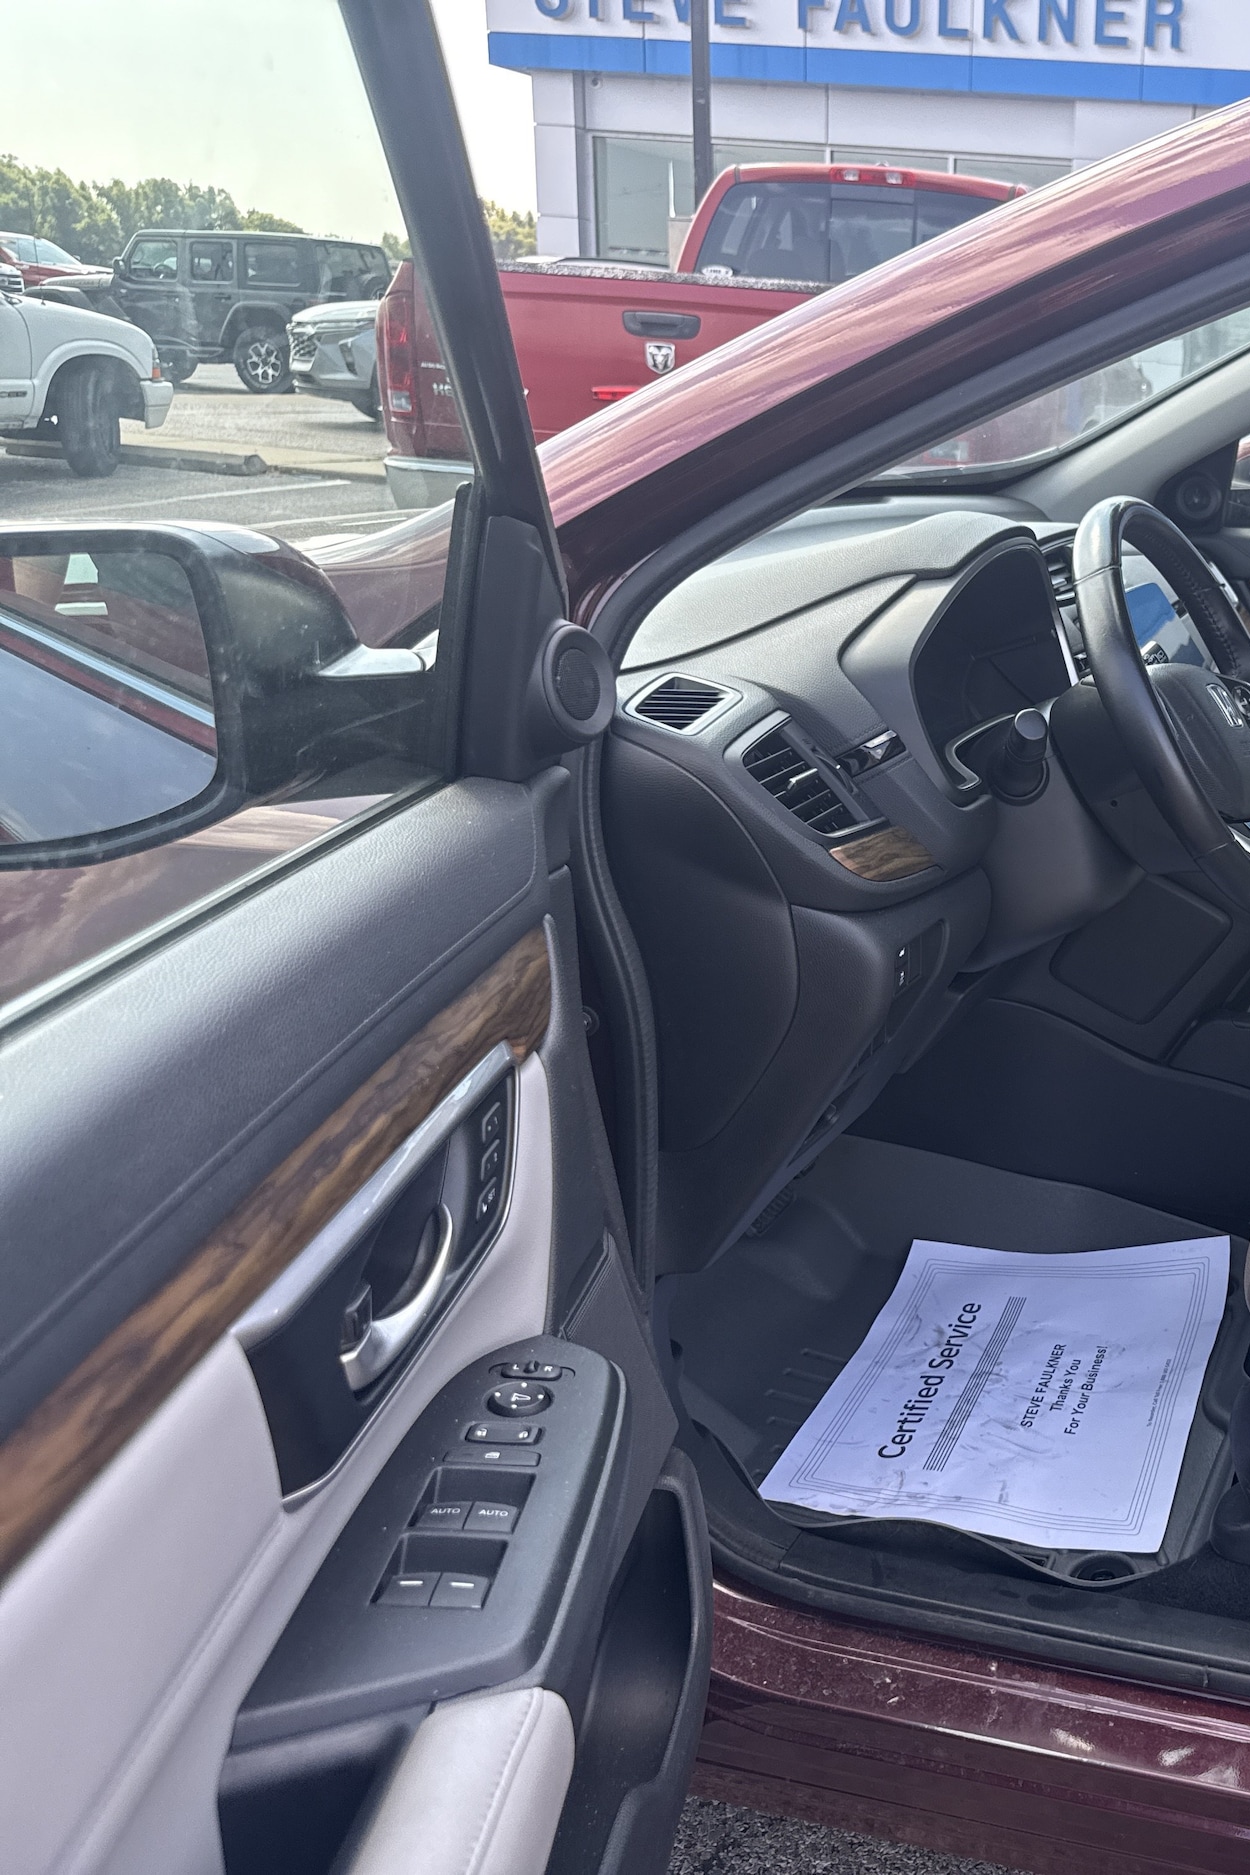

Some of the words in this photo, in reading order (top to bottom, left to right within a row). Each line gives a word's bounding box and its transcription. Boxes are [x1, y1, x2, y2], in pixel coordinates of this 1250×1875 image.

[877, 1375, 946, 1459] Certified
[928, 1302, 982, 1370] Service
[1020, 1395, 1045, 1428] STEVE
[1034, 1343, 1067, 1394] FAULKNER
[1048, 1378, 1074, 1411] Thanks
[1063, 1359, 1081, 1377] You
[1080, 1345, 1108, 1391] Business!
[1063, 1417, 1081, 1435] For
[1070, 1392, 1091, 1415] Your
[478, 1508, 509, 1517] AUTO
